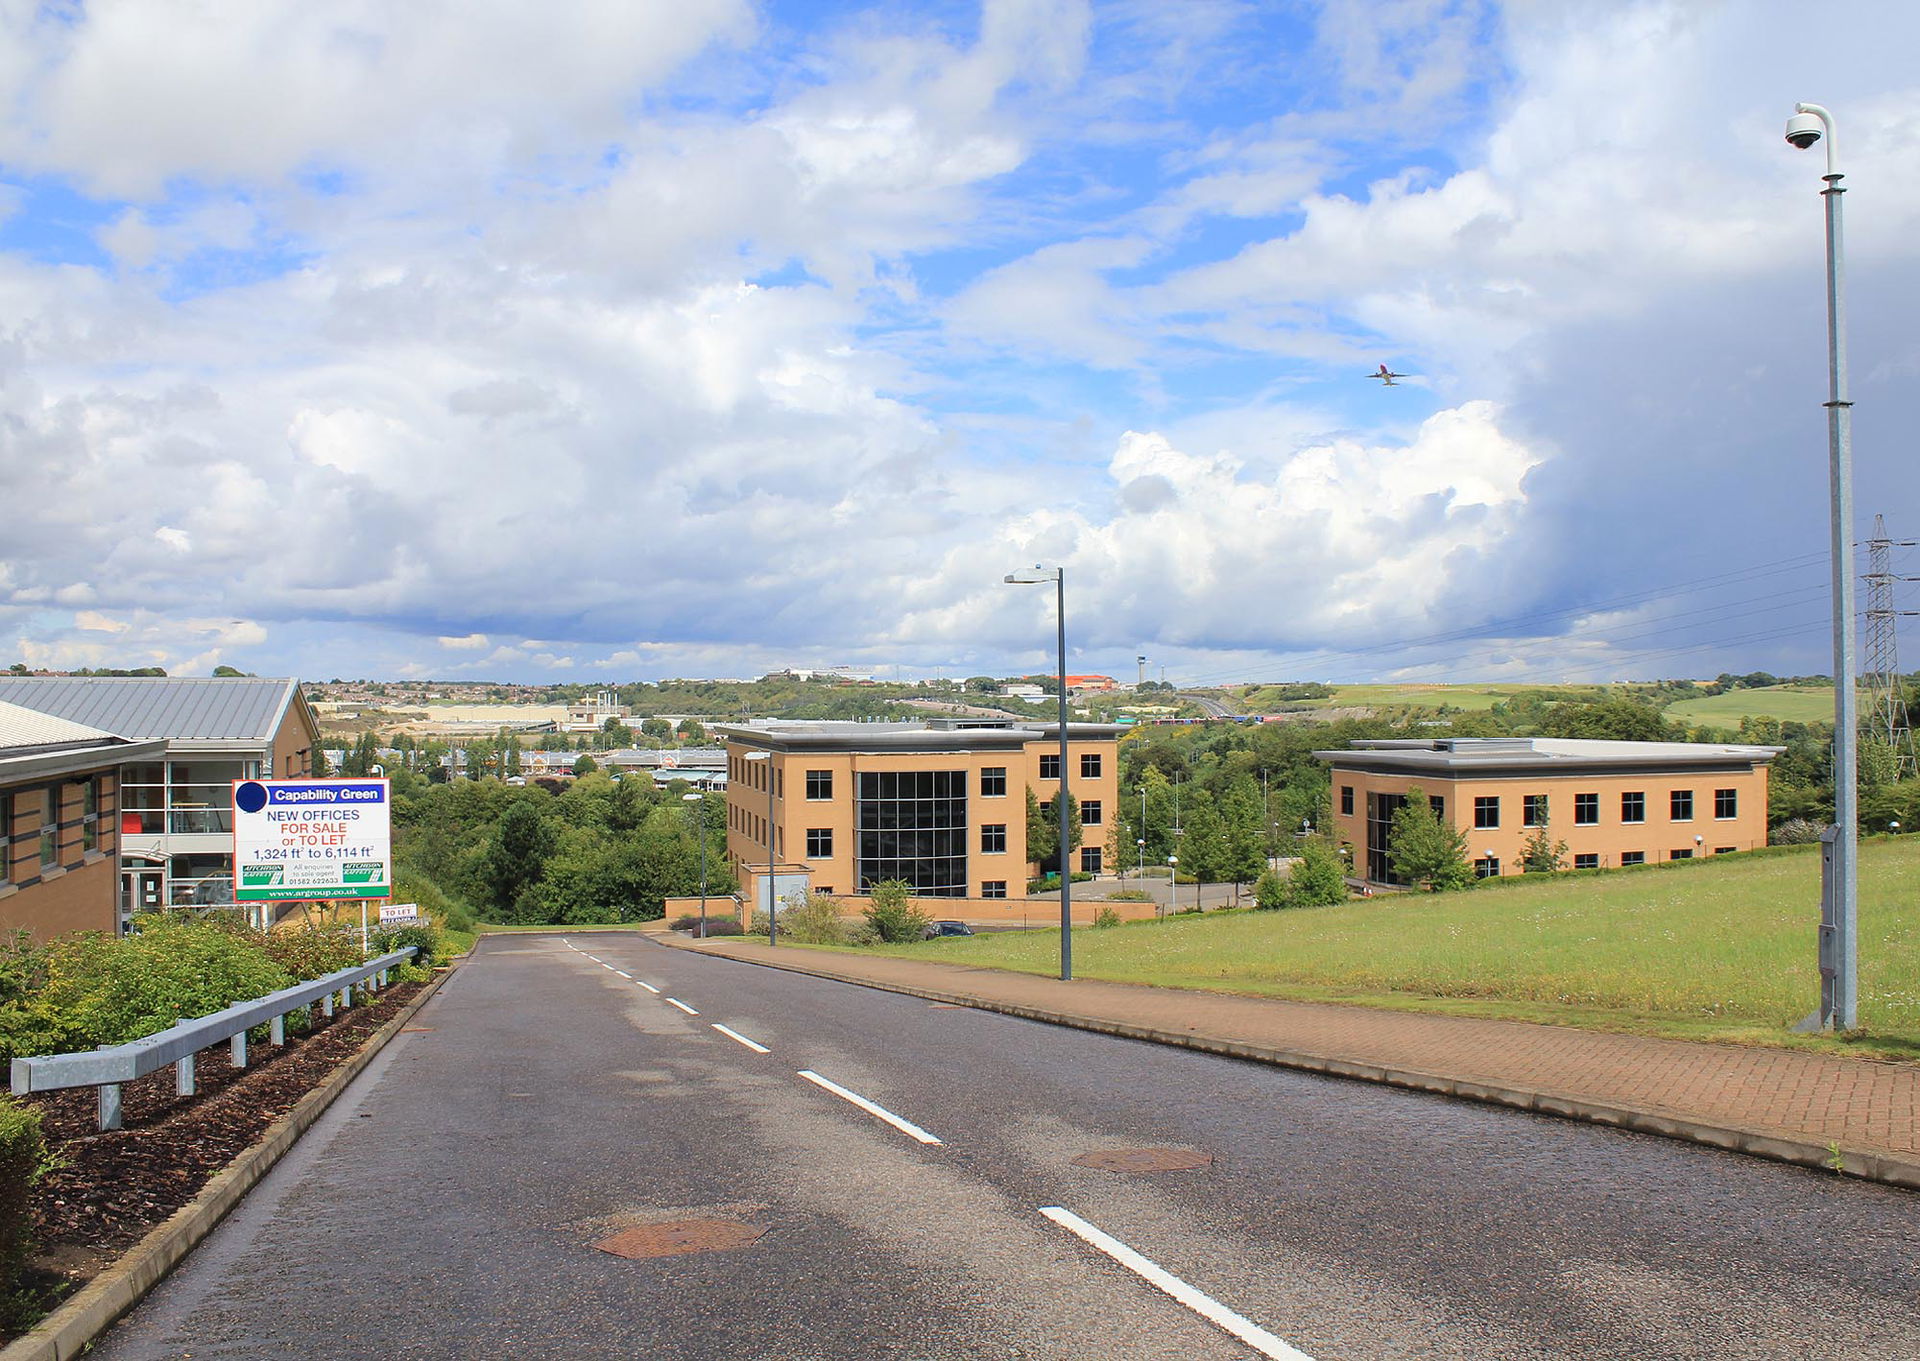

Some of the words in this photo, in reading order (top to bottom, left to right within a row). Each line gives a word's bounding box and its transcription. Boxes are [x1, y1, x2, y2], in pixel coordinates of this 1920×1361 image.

[275, 789, 337, 802] Capability
[341, 788, 378, 800] Green
[267, 811, 298, 821] NEW
[302, 809, 360, 821] OFFICES
[281, 823, 309, 833] FOR
[312, 823, 347, 833] SALE
[282, 837, 295, 846] or
[299, 835, 317, 845] TO
[321, 834, 346, 845] LET
[254, 849, 287, 861] 1,324
[309, 848, 321, 858] to
[325, 847, 357, 860] 6,114
[304, 863, 334, 872] enquiries
[315, 870, 334, 878] agent
[269, 887, 358, 898] www.argroup.co.uk
